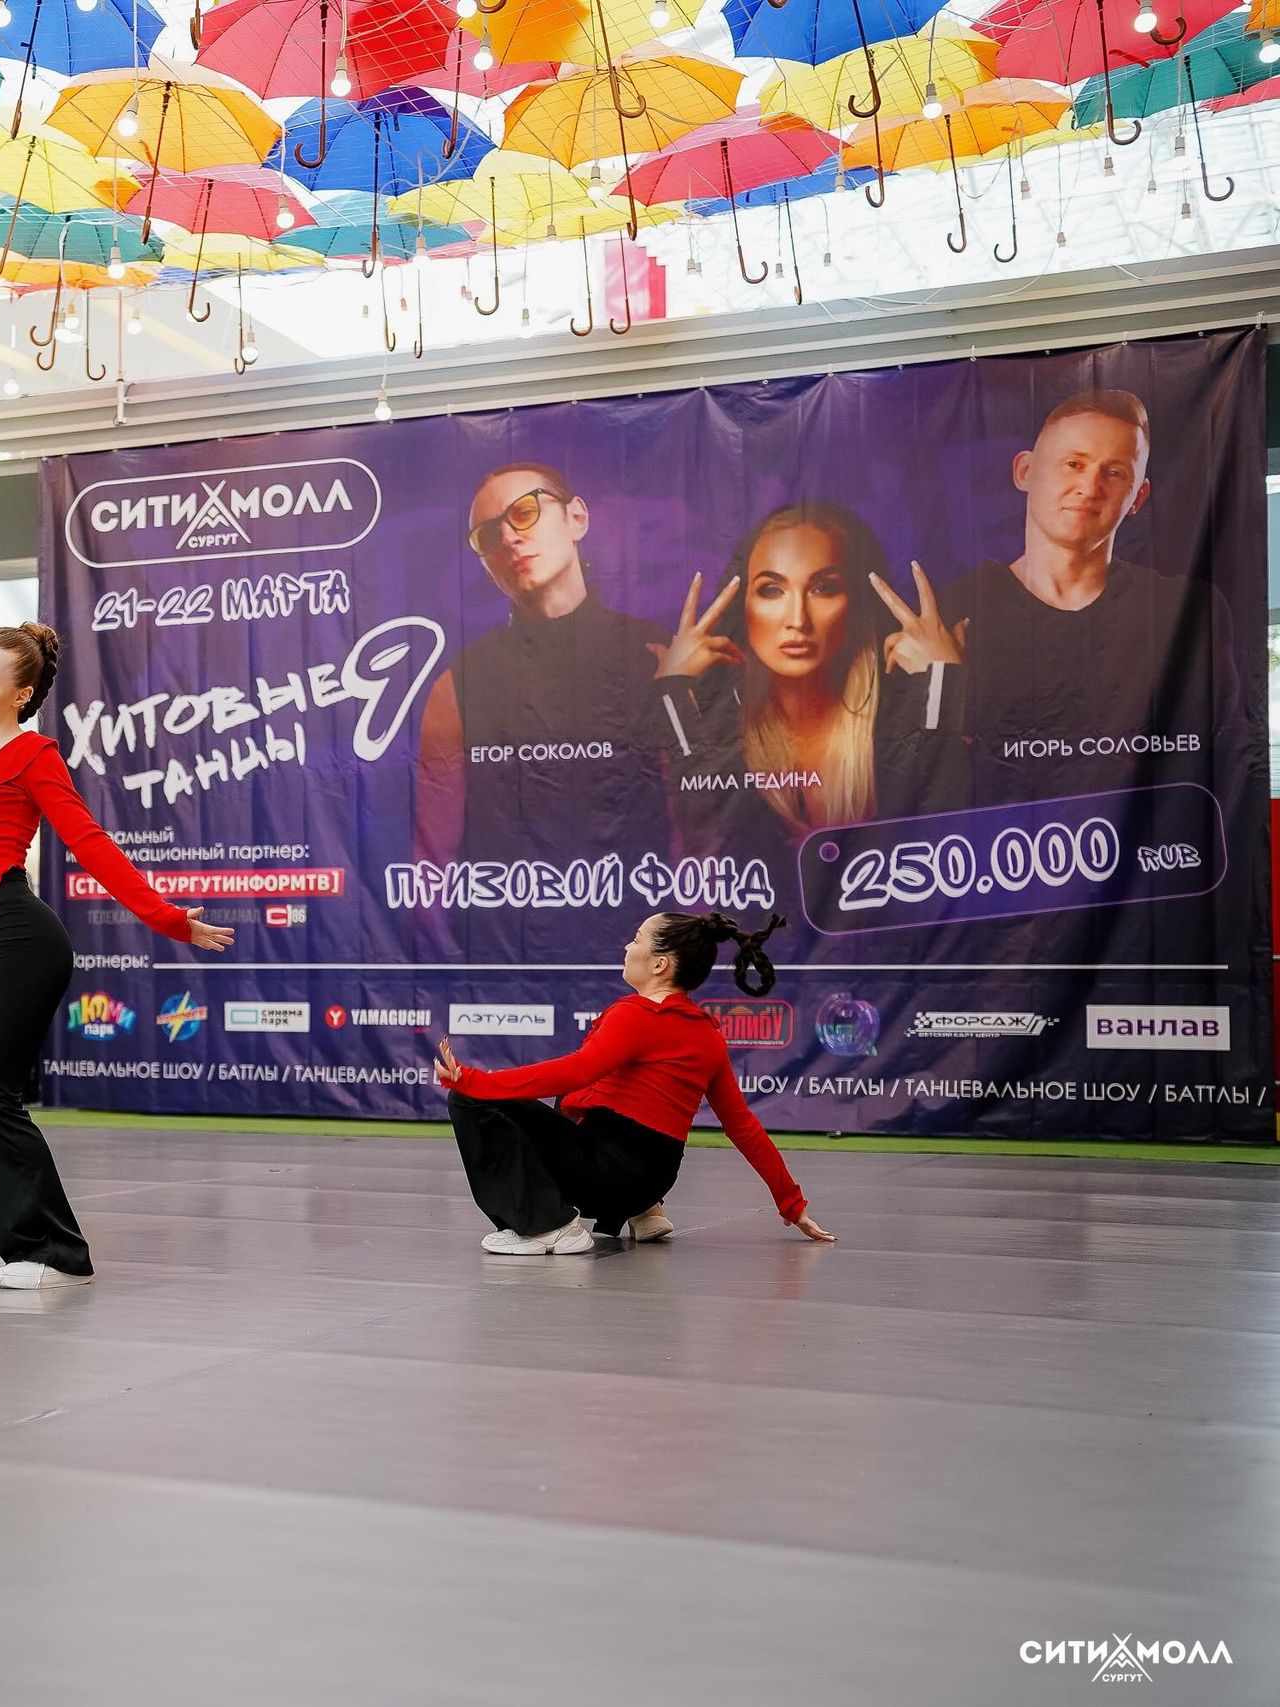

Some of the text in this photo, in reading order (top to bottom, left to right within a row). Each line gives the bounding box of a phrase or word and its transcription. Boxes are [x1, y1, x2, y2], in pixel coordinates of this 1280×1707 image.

[91, 478, 353, 533] СИТИ МОЛЛ
[187, 532, 239, 549] СУРГУТ
[91, 568, 351, 632] 21-22 МАРТА
[470, 741, 614, 763] ЕГОР СОКОЛОВ
[1003, 733, 1201, 758] ИГОРЬ СОЛОВЬЕВ
[122, 721, 306, 809] ТАНЦЫ
[680, 771, 822, 792] МИЛА РЕДИНА
[107, 827, 175, 845] альный
[66, 842, 310, 863] имационный партнер:
[838, 816, 1202, 912] 250.000 RUB
[384, 852, 775, 910] ПРИЗОВОЙ ФОНД
[88, 908, 141, 925] ТЕЛЕКАН
[73, 951, 150, 972] артнеры:
[261, 1018, 289, 1027] парк
[351, 1008, 431, 1026] YAMAGUCHI
[935, 1016, 1026, 1027] ФОРСАЖ
[1096, 1018, 1220, 1037] ванлав
[84, 1023, 115, 1038] парк
[44, 1058, 159, 1079] ТАНЦЕВАЛЬНОЕ
[163, 1062, 204, 1080] ШОУ
[219, 1064, 279, 1082] БАТТЛЫ
[295, 1065, 428, 1086] ТАНЦЕВАЛЬНОЕ
[738, 1074, 789, 1094] ШОУ
[809, 1076, 884, 1096] БАТТЛЫ
[904, 1078, 1076, 1101] ТАНЦЕВАЛЬНОЕ
[1083, 1081, 1141, 1102] ШОУ
[1164, 1085, 1250, 1106] БАТТЛЫ
